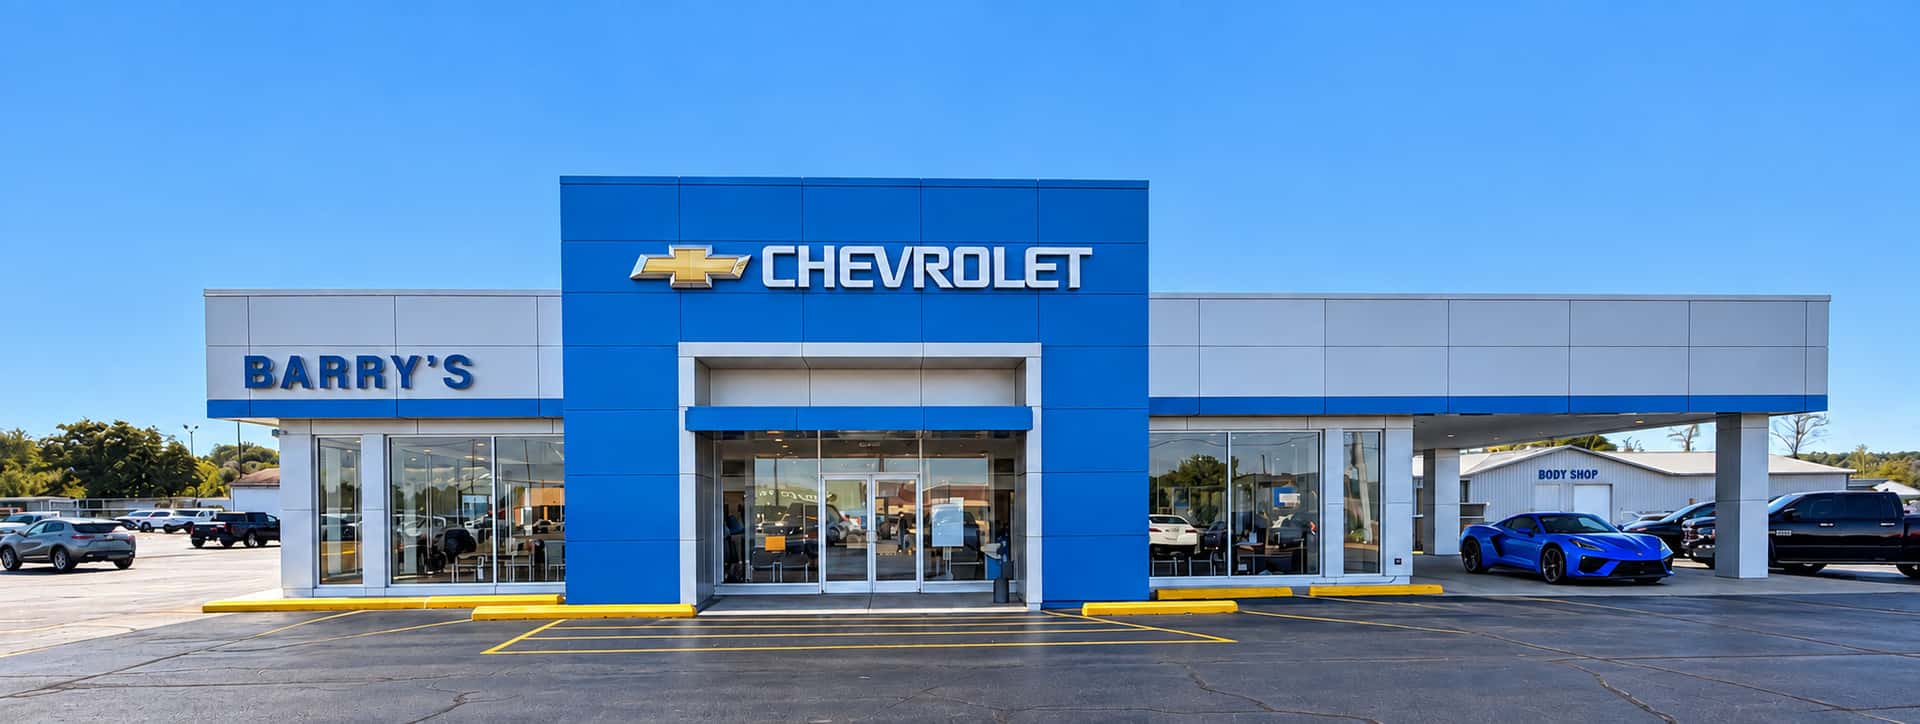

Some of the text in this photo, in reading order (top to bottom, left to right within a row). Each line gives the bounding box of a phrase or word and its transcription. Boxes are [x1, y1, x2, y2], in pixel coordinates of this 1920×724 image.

[762, 245, 1093, 289] CHEVROLET
[244, 354, 475, 390] BARRY'S
[1538, 469, 1599, 480] BODY SHOP
